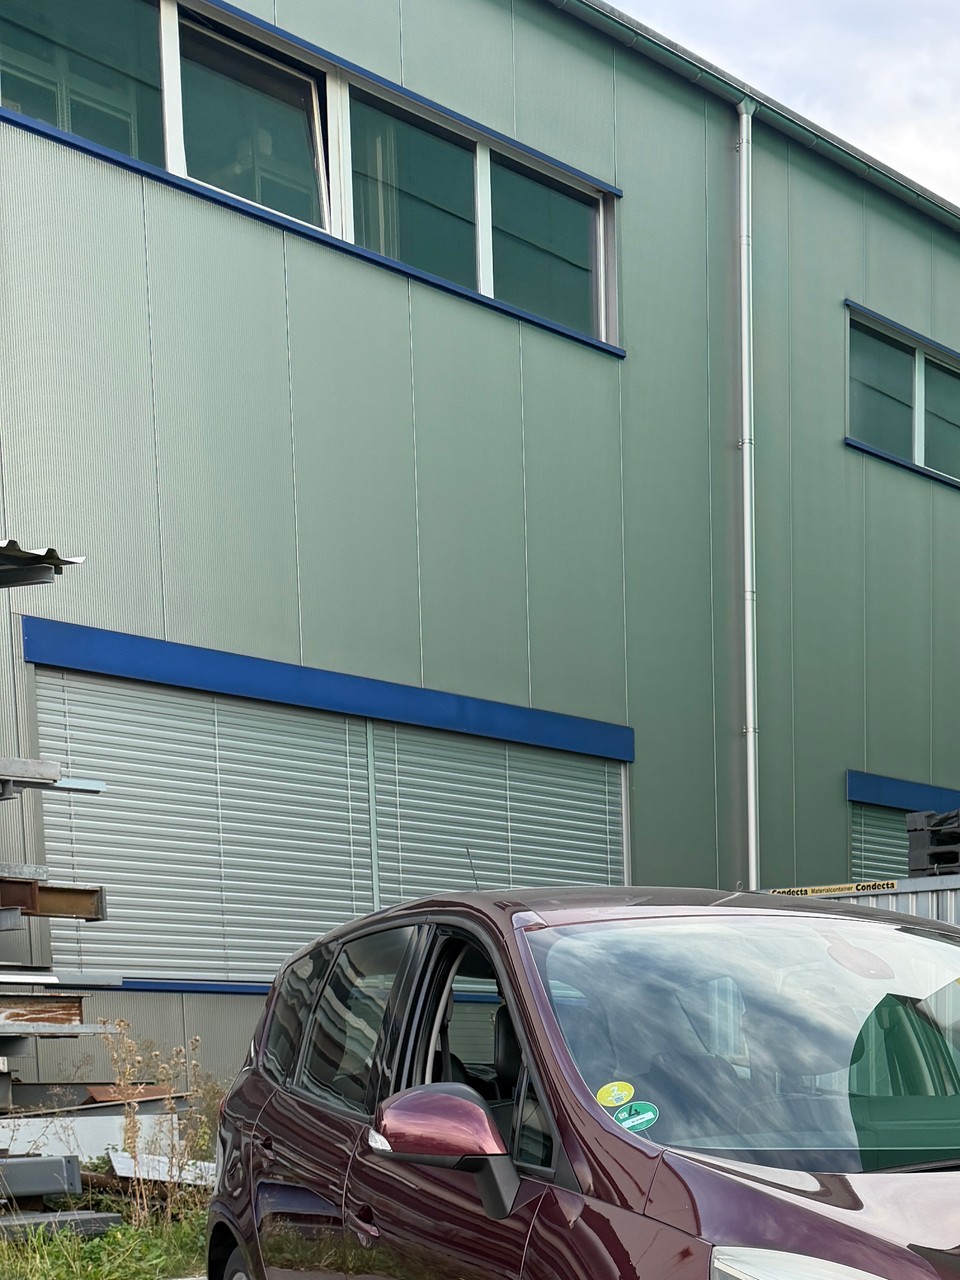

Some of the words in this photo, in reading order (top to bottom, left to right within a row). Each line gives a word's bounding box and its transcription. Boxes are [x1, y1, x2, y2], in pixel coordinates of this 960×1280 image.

[811, 885, 854, 894] Materialcontainer
[855, 881, 895, 892] Condecta
[628, 1104, 640, 1117] 4
